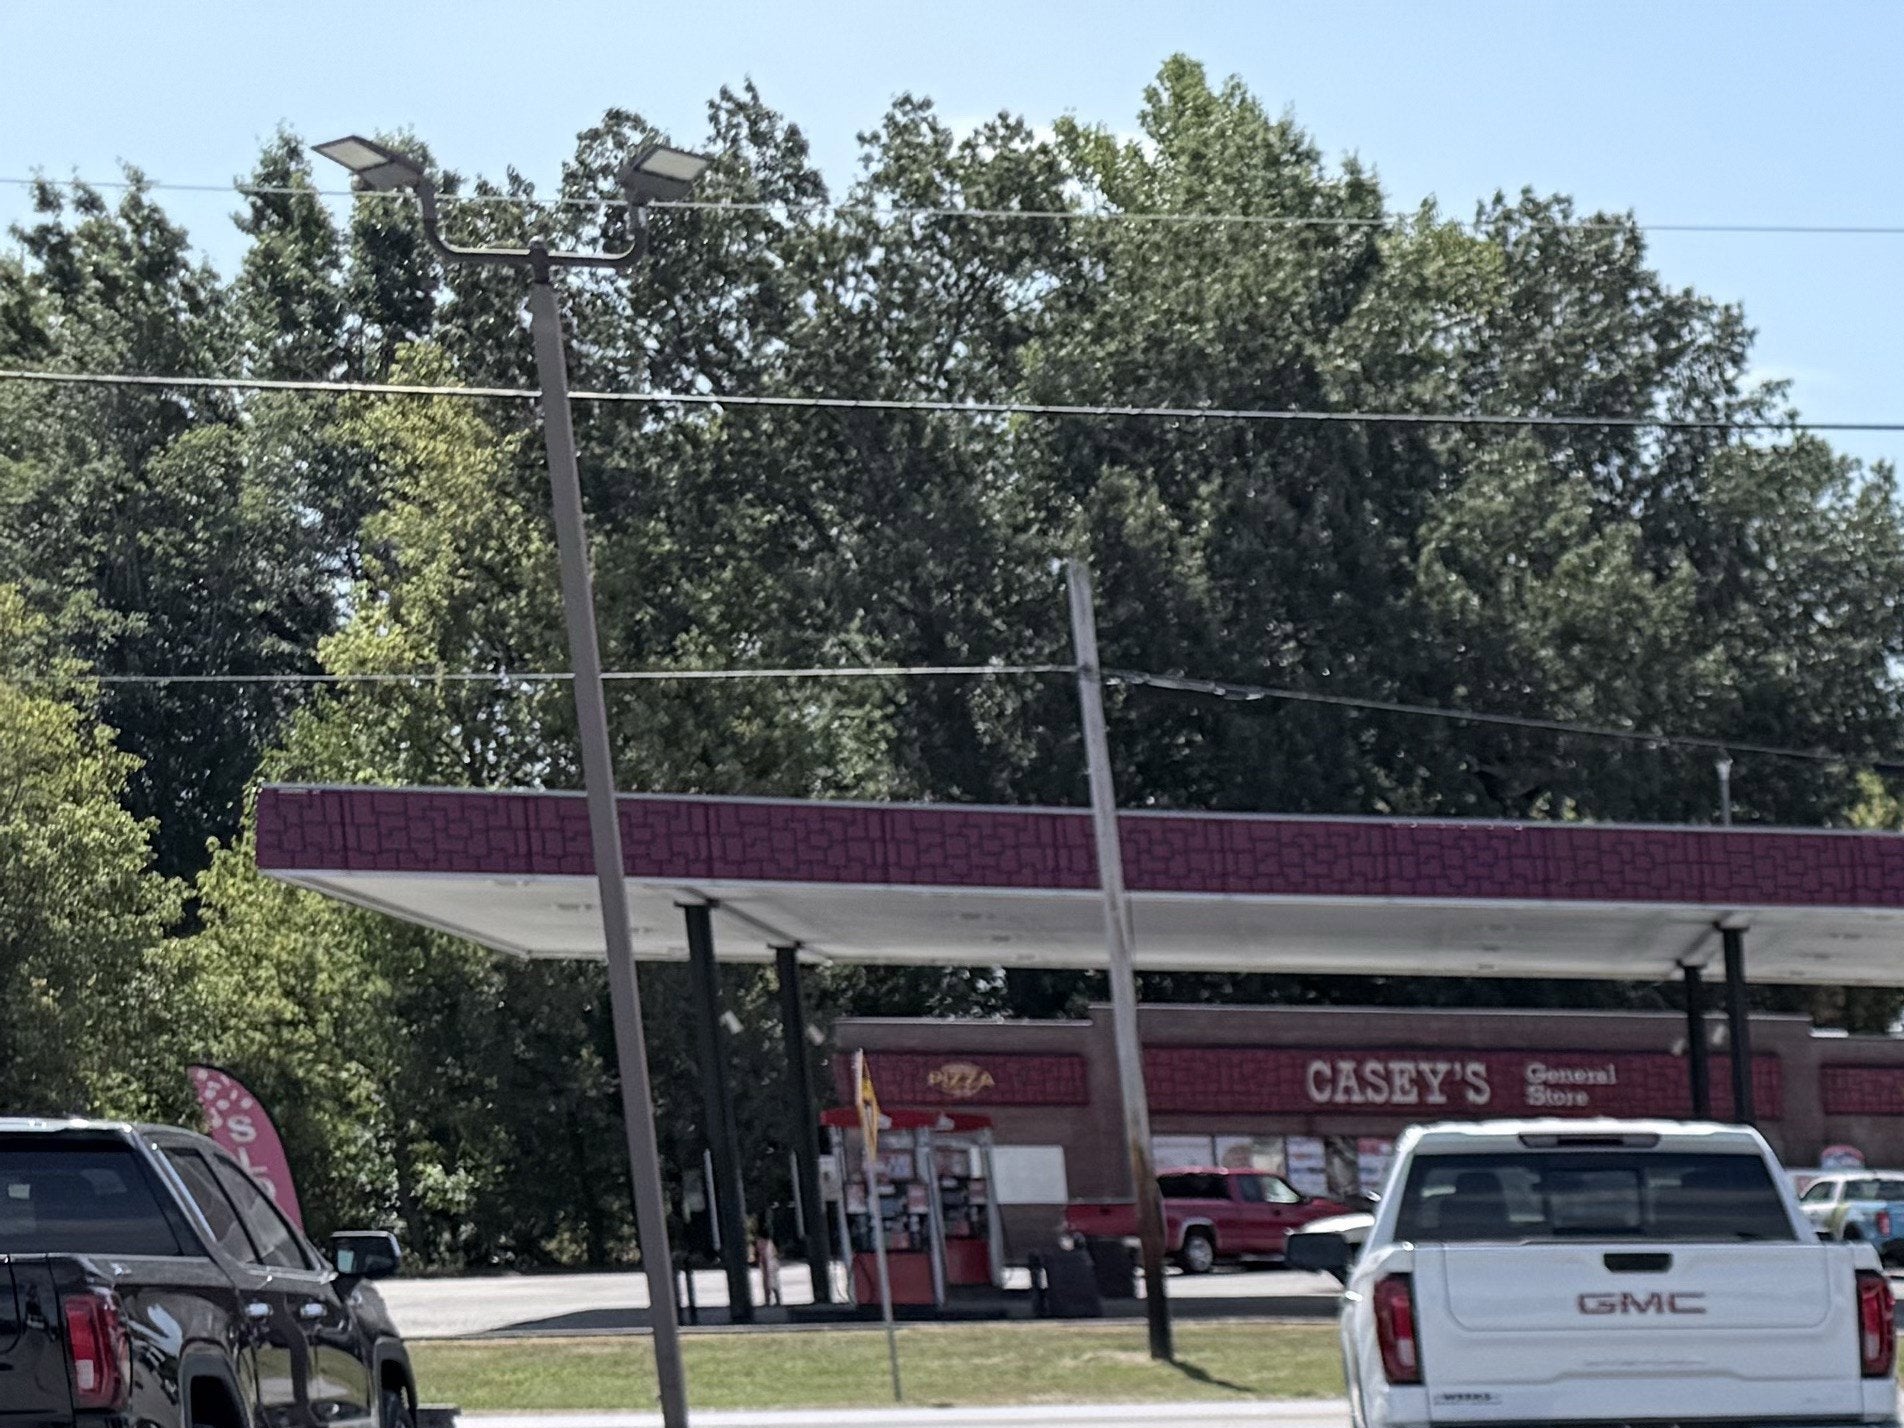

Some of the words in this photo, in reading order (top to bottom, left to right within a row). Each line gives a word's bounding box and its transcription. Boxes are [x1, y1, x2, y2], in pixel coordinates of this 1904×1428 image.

[926, 1070, 996, 1091] PIZZA
[1306, 1059, 1492, 1105] CASEY'S
[1524, 1061, 1618, 1085] General
[1524, 1083, 1591, 1107] Store
[1576, 1291, 1707, 1315] GMC
